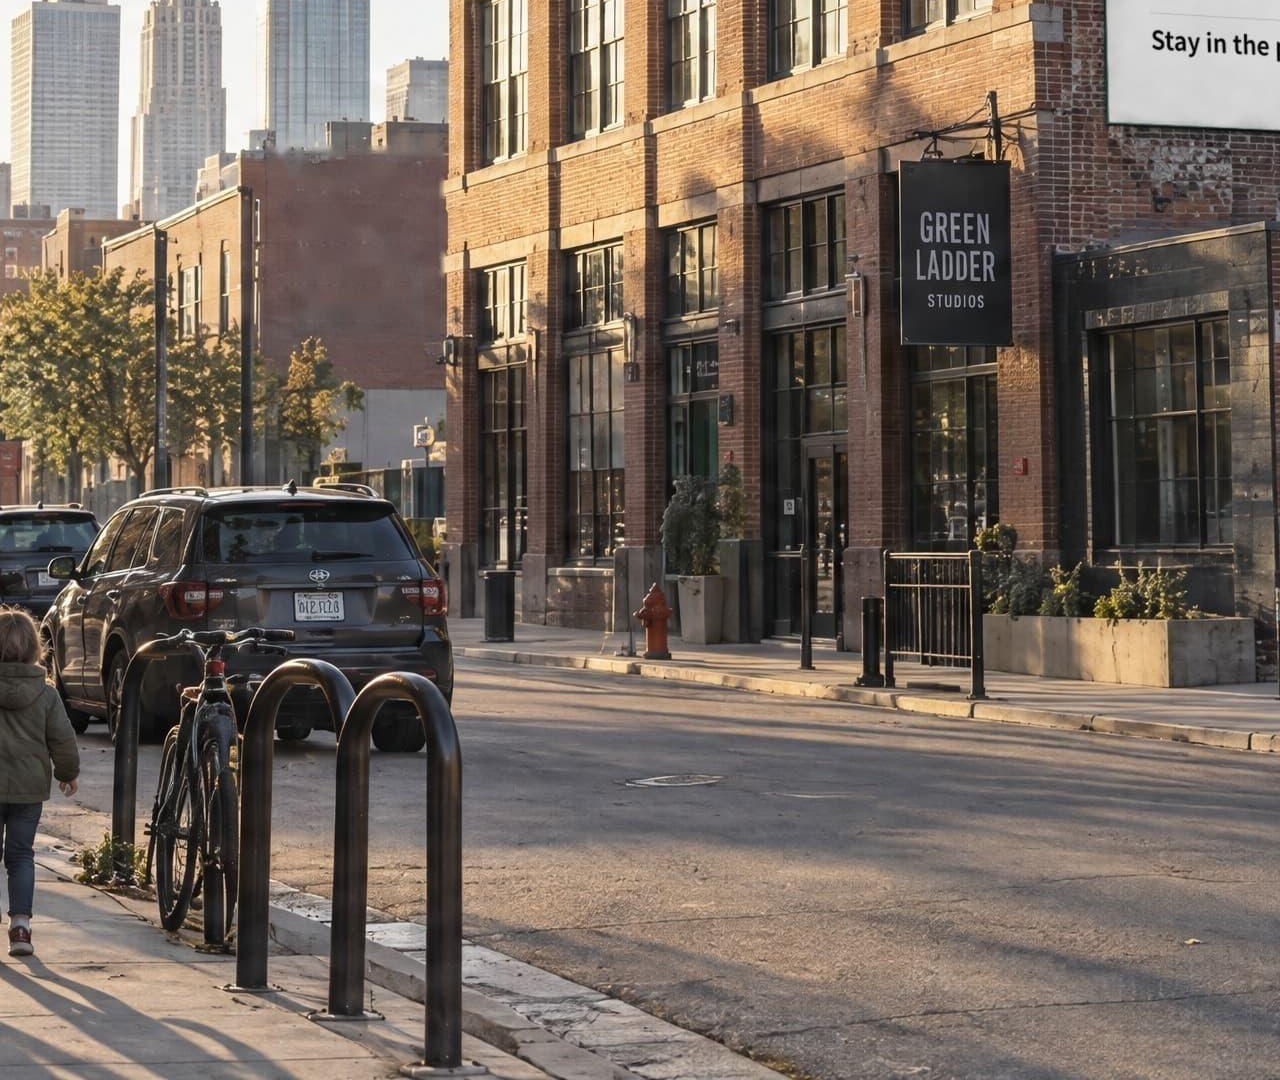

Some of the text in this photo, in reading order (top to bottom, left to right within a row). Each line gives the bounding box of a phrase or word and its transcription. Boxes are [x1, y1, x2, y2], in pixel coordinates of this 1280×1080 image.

[1151, 29, 1201, 58] Stay
[1206, 31, 1227, 54] in
[1232, 33, 1270, 57] the
[920, 211, 990, 245] GREEN
[916, 248, 996, 282] LADDER
[927, 293, 985, 309] STUDIOS
